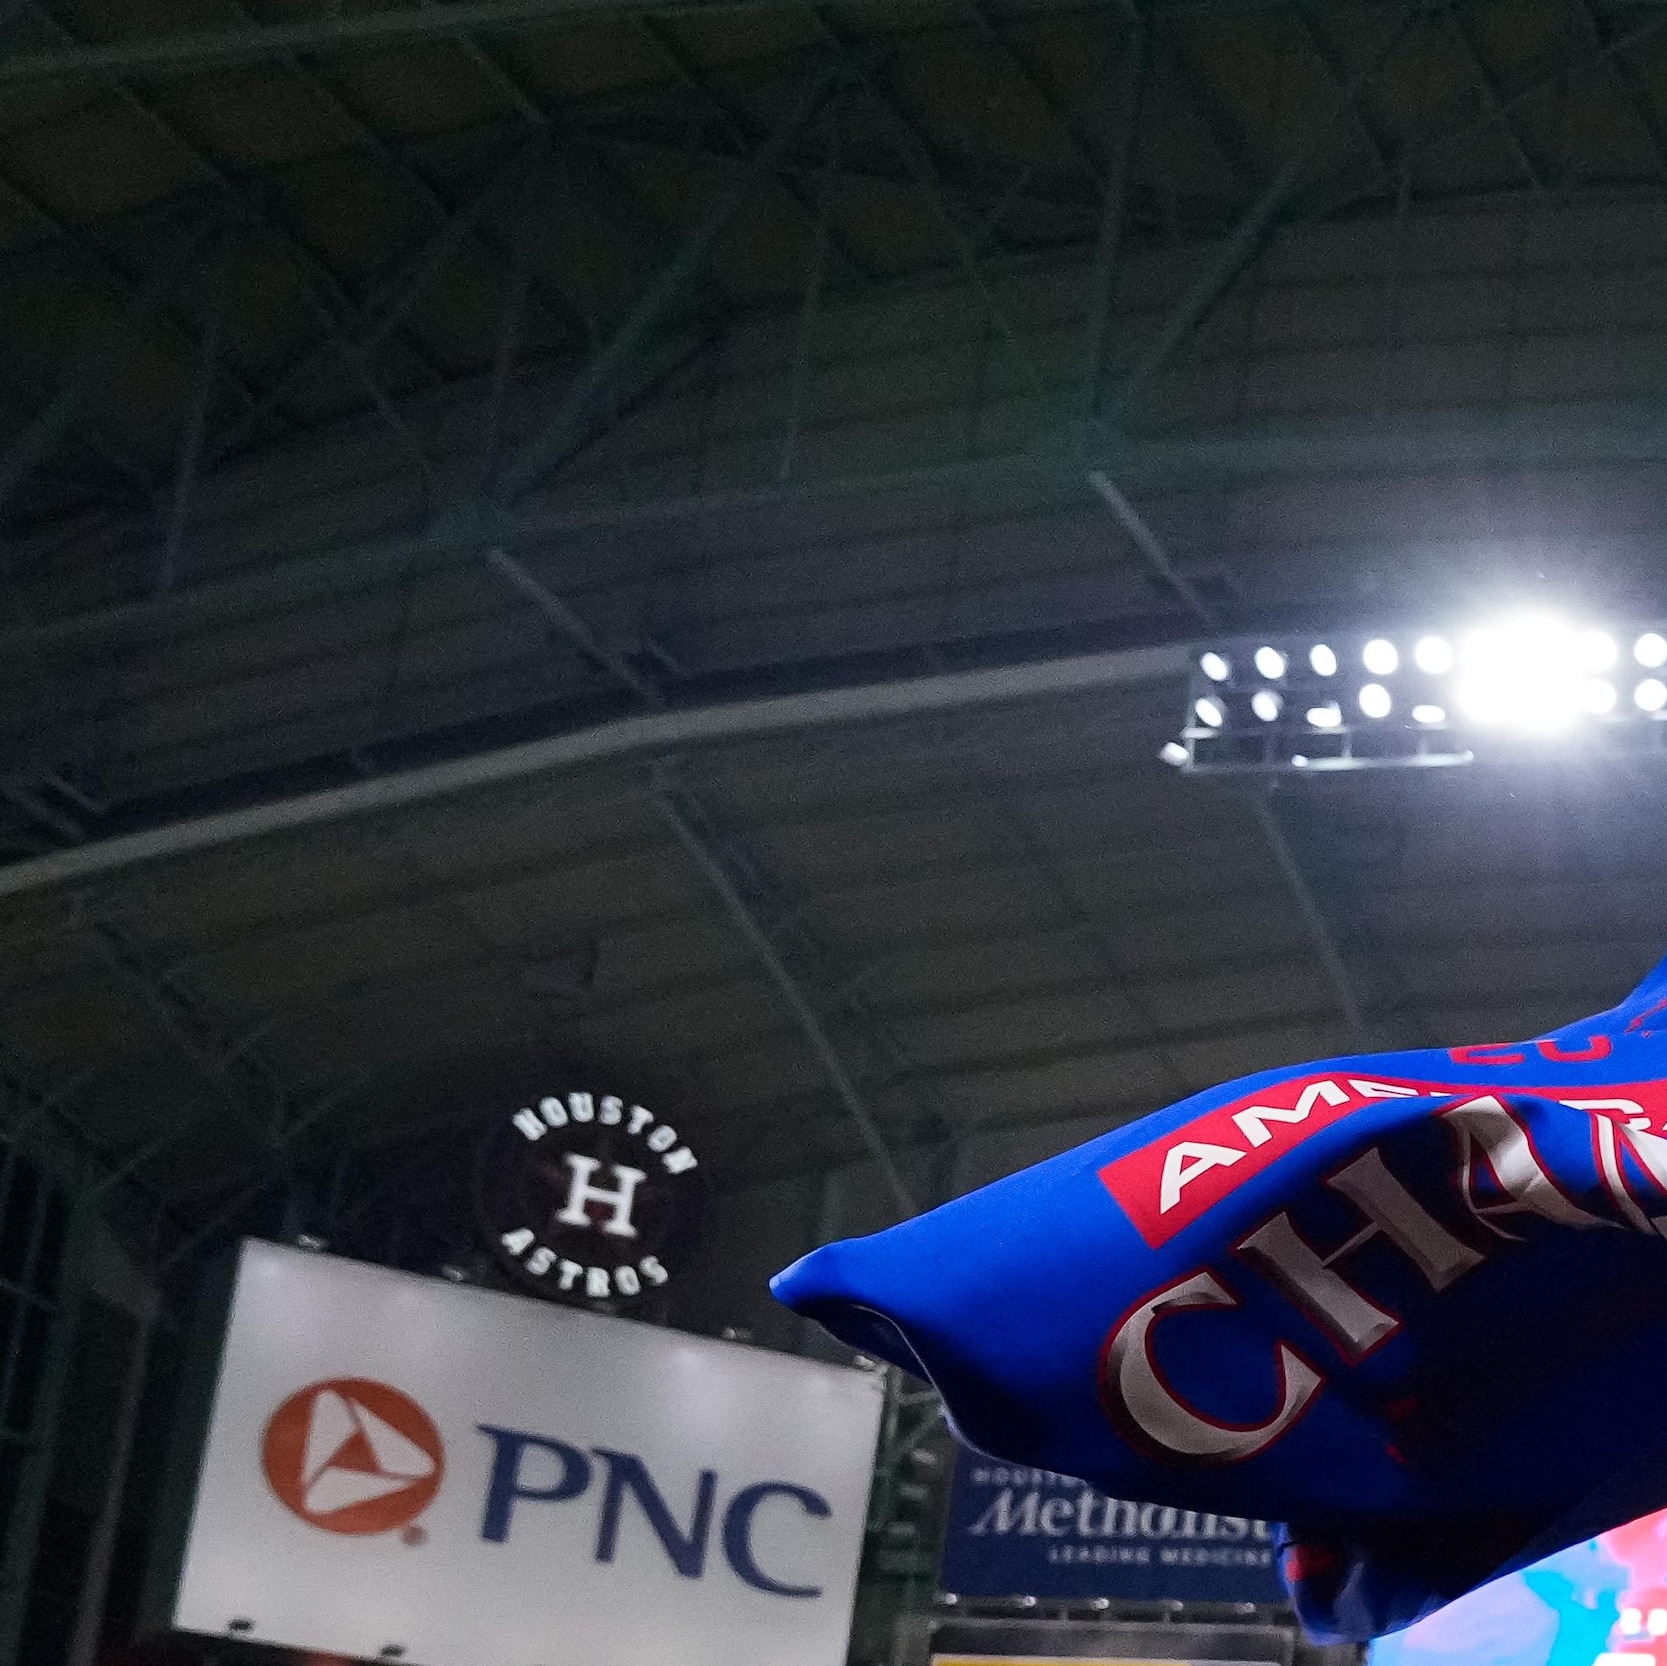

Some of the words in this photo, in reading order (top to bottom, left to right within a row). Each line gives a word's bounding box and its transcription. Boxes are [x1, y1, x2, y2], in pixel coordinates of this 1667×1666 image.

[512, 1091, 698, 1176] HOUSTON
[557, 1154, 647, 1238] H
[500, 1226, 669, 1299] ASTROS
[475, 1422, 833, 1600] PNC
[969, 1488, 1272, 1540] Methodist
